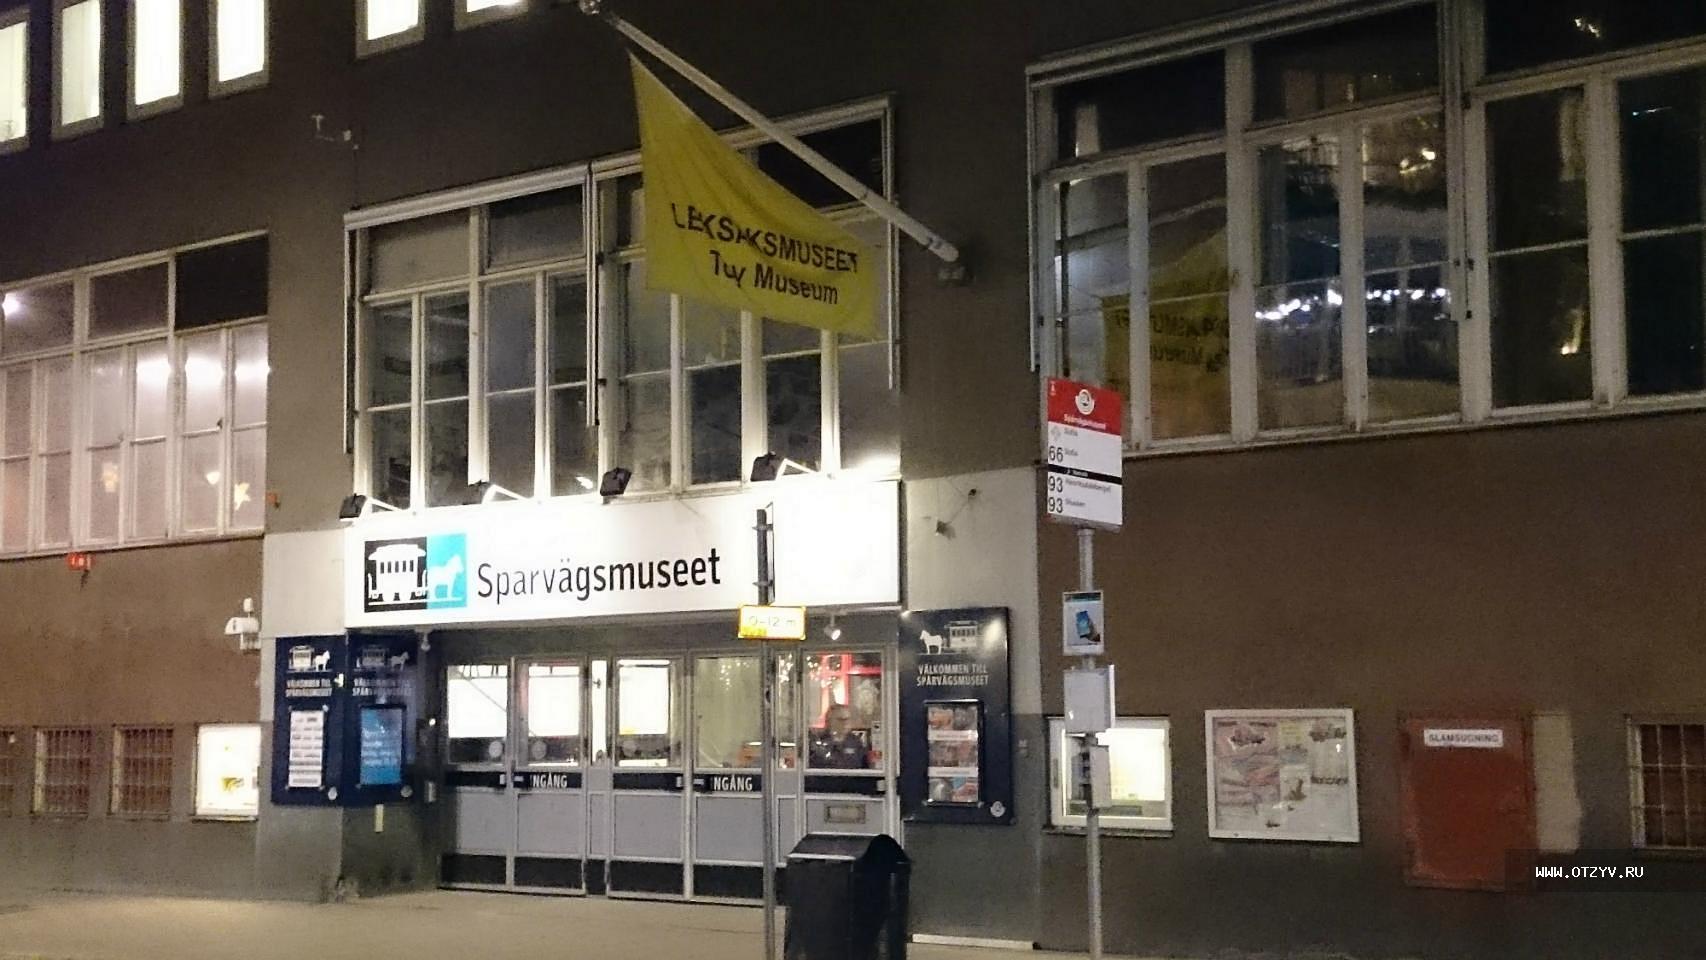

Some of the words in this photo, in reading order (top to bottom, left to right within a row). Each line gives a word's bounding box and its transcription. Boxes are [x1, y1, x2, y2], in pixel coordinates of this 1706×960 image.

[754, 263, 838, 304] Museum
[1048, 446, 1063, 462] 66
[1048, 476, 1063, 493] 93
[1048, 497, 1063, 513] 93
